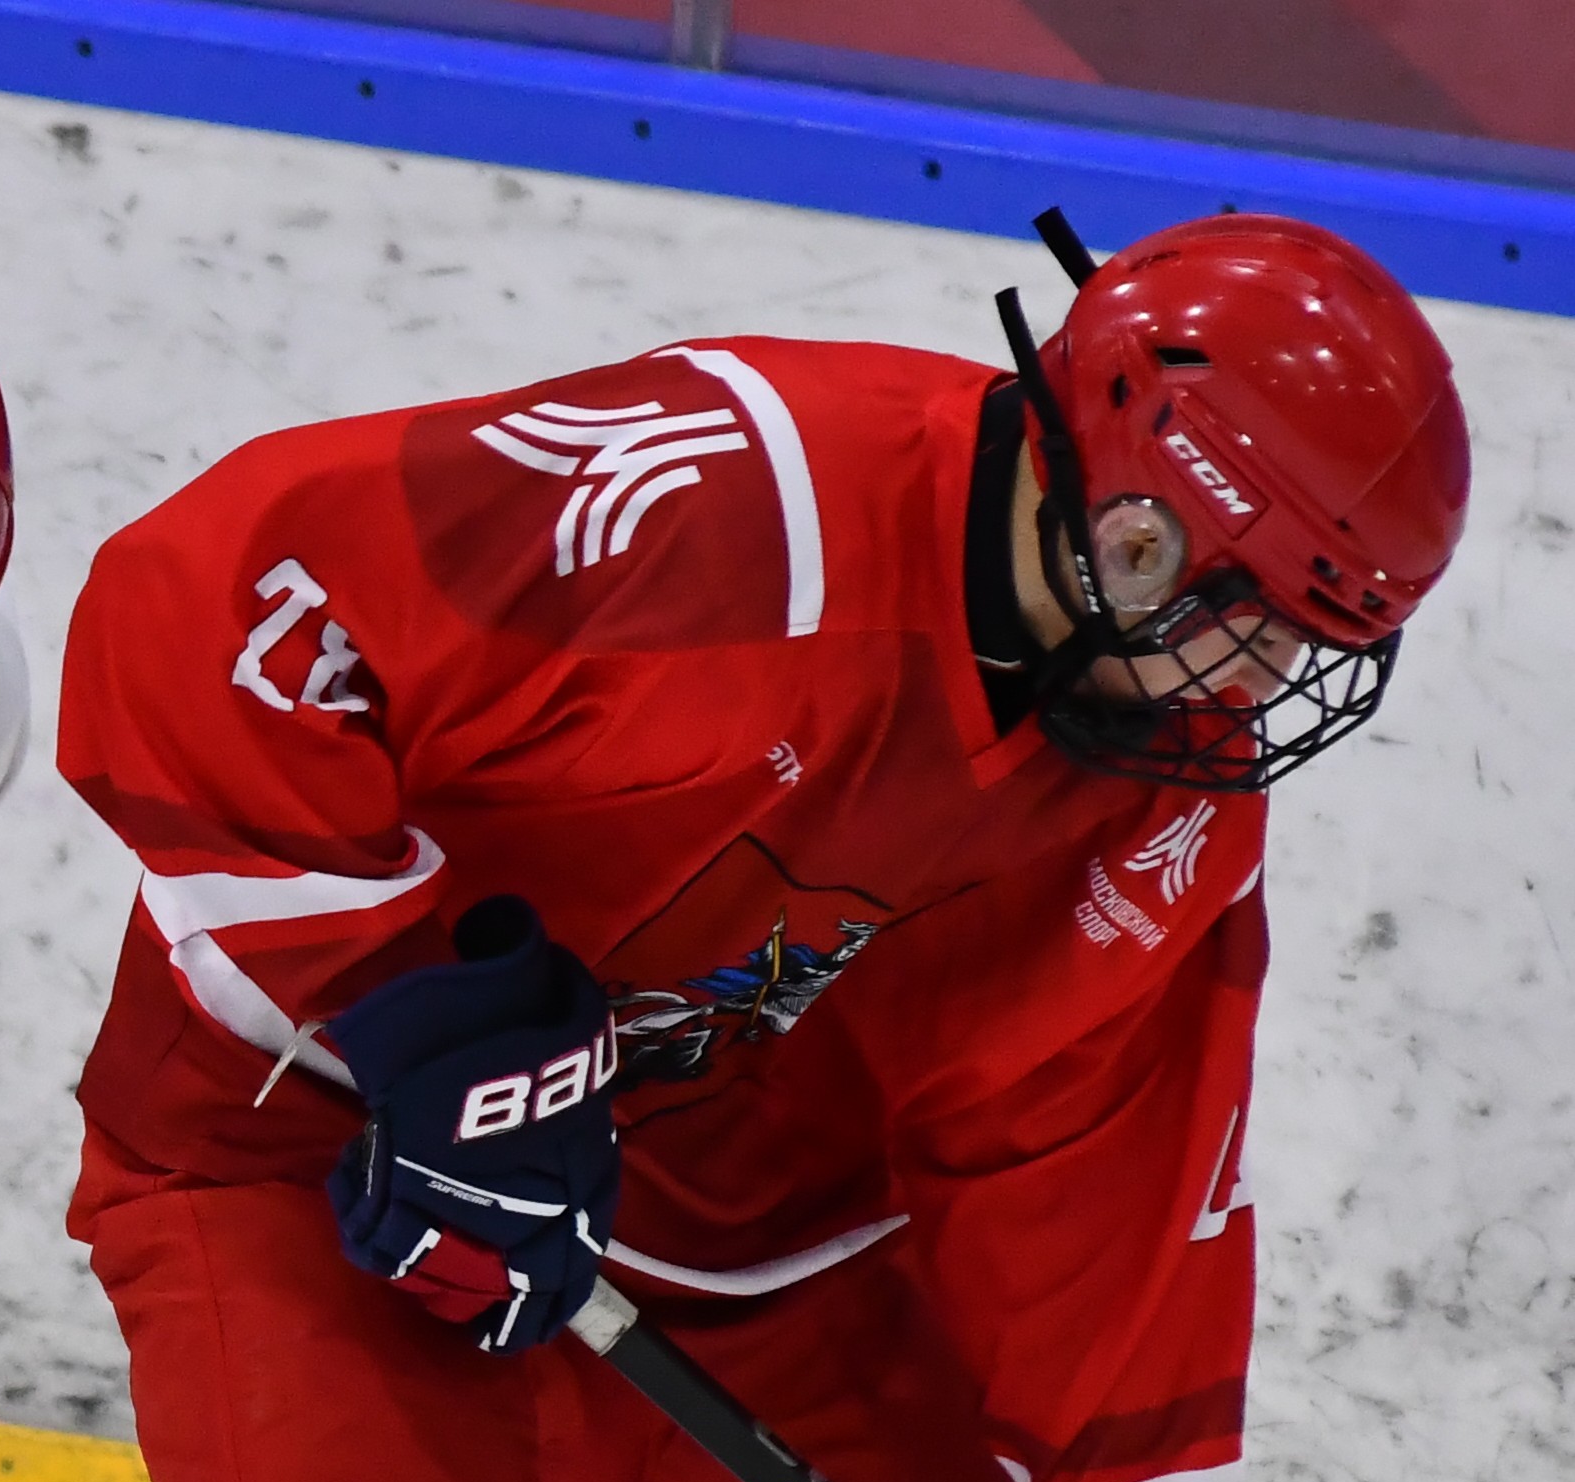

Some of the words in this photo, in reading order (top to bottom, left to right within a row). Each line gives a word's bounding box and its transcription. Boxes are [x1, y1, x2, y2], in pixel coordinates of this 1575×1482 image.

[1165, 431, 1254, 514] CCM
[1075, 901, 1122, 949] СПОРТ
[427, 1180, 494, 1207] SUPREME
